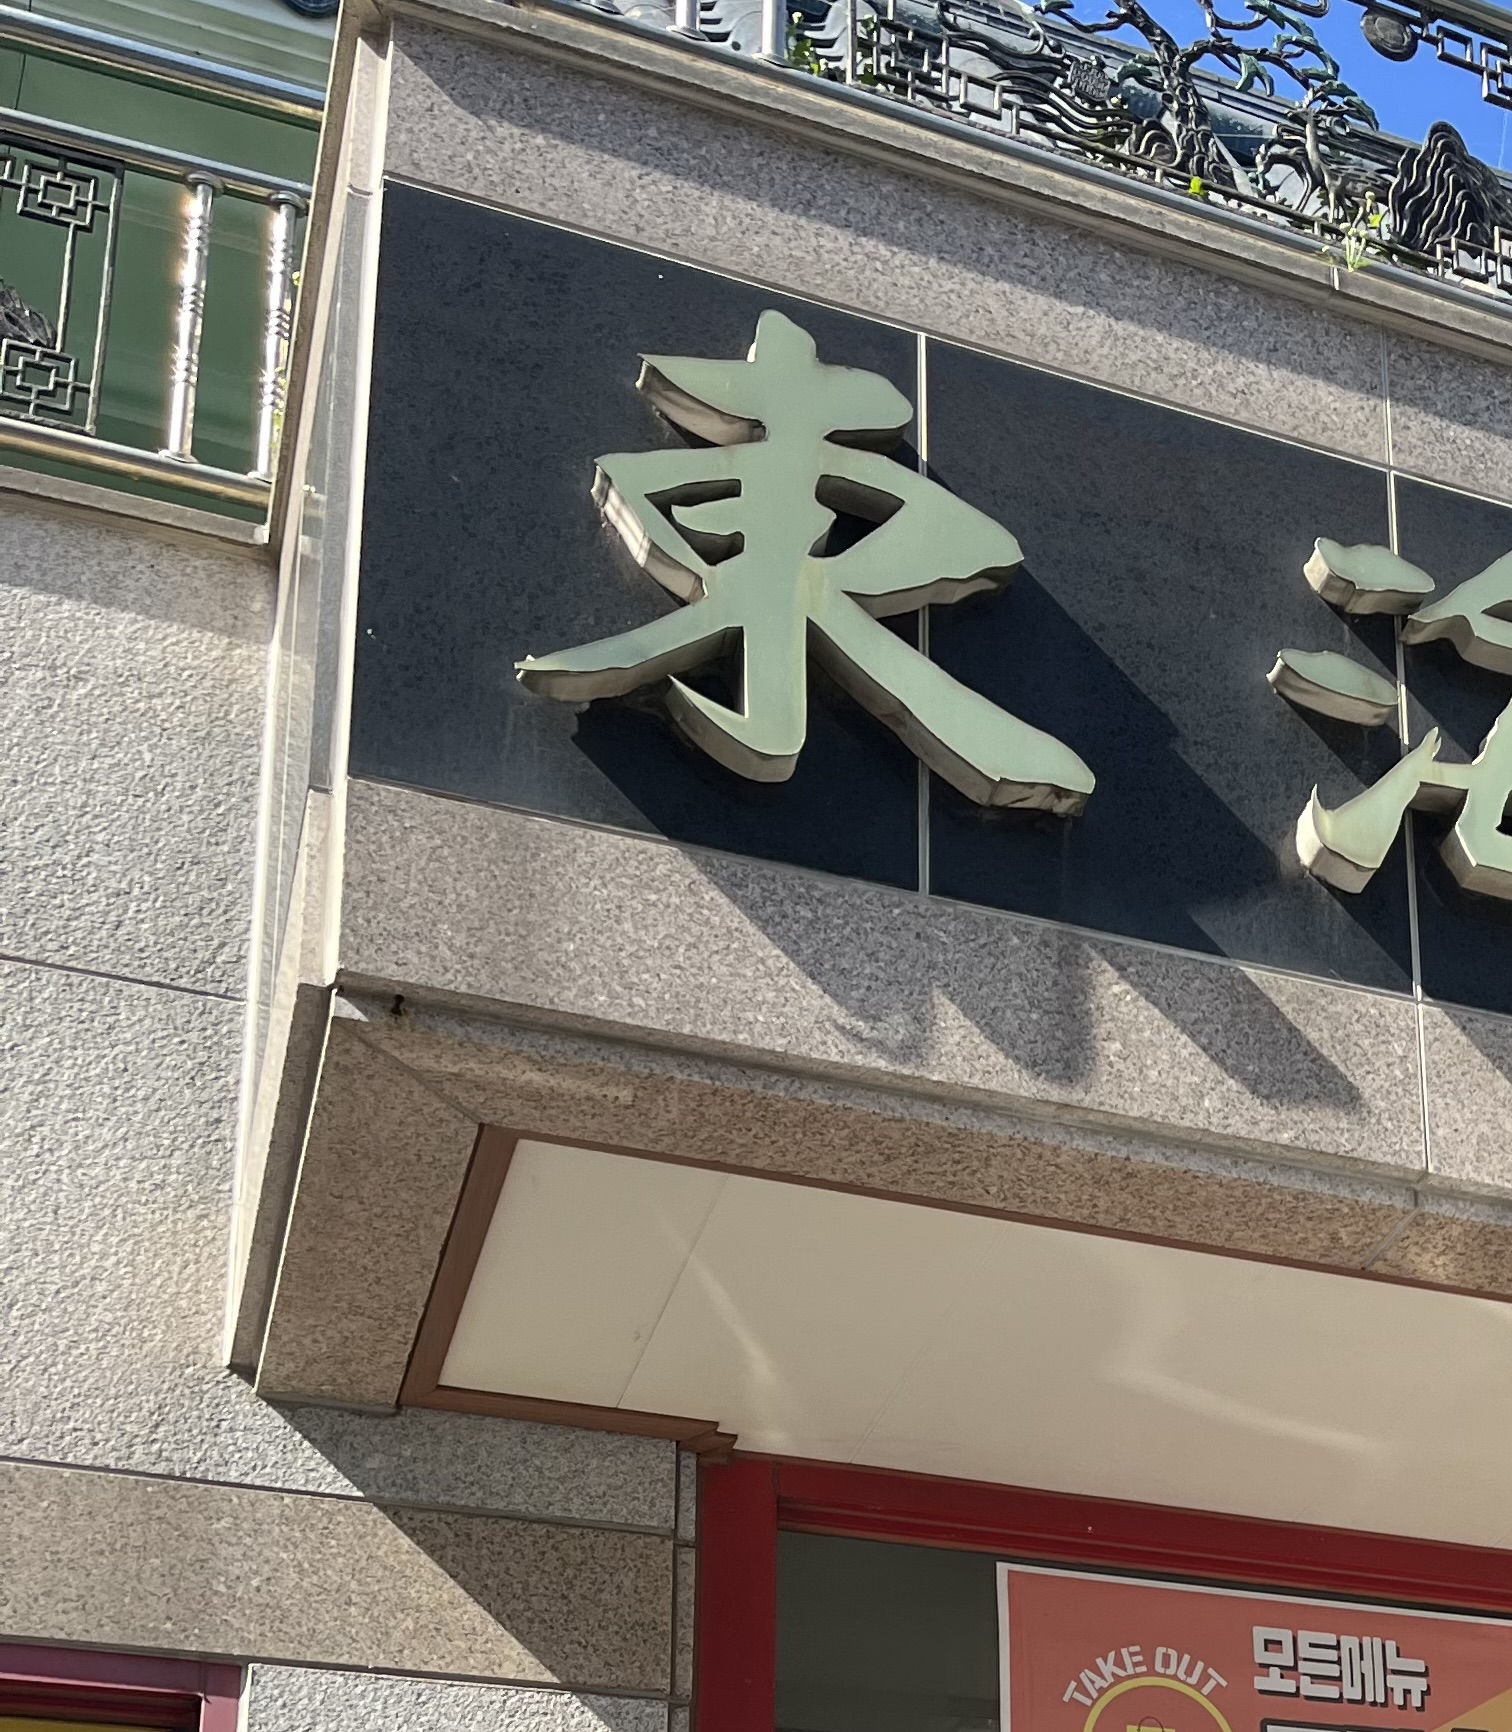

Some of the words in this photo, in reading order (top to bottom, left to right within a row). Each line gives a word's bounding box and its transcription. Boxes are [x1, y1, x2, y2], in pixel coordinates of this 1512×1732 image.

[1063, 1645, 1148, 1712] TAKE
[1153, 1645, 1228, 1699] OUT
[1251, 1624, 1429, 1711] 모든메뉴
